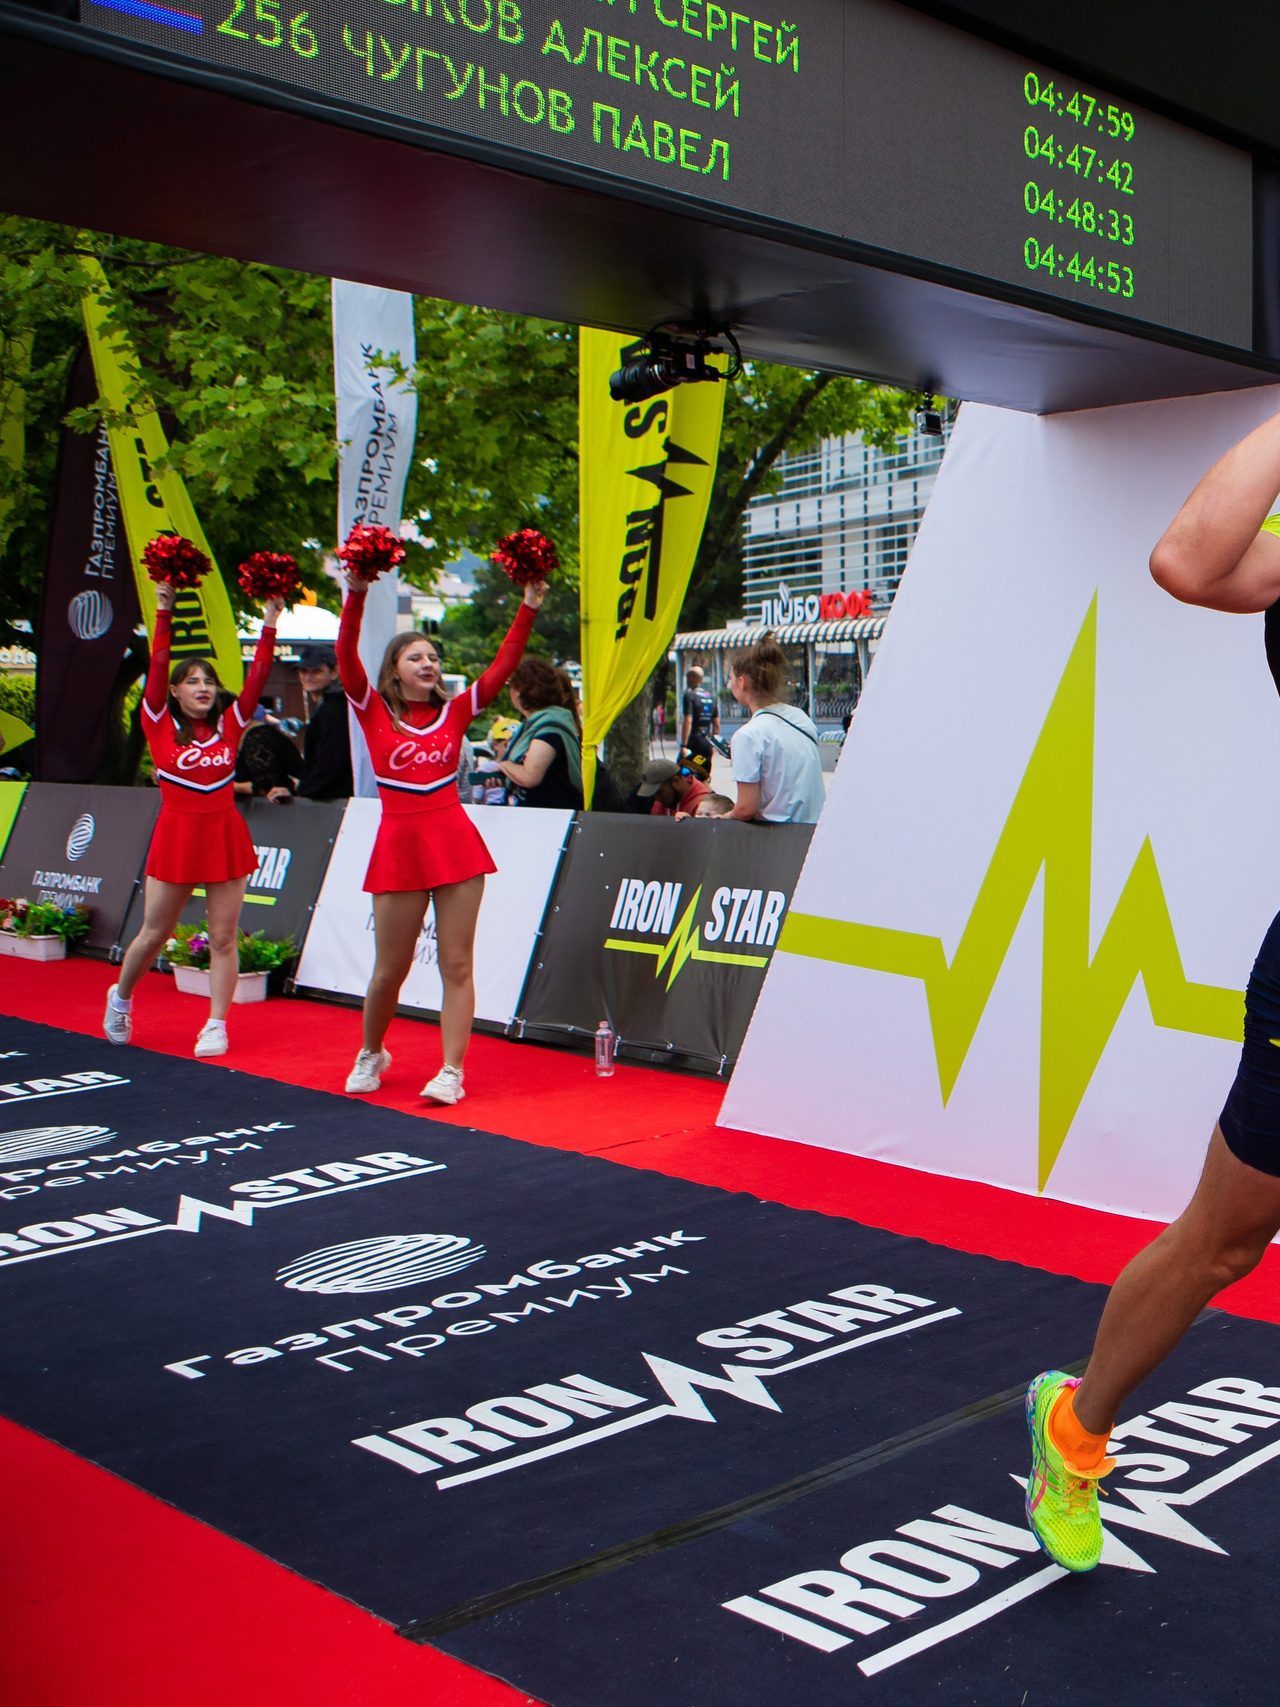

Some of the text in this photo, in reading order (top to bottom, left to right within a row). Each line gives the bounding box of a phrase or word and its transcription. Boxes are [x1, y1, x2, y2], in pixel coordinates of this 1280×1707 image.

[541, 20, 740, 118] АЛЕКСЕЙ
[655, 0, 799, 73] СЕРГЕЙ
[217, 0, 730, 181] 256 ЧУГУНОВ ПАВЕЛ
[1024, 72, 1135, 142] 04:47:59
[1024, 126, 1135, 196] 04:47:42
[1024, 181, 1135, 246] 04:48:33
[1024, 237, 1135, 298] 04:44:53
[84, 416, 113, 577] ГАЗПРОМБАН
[369, 413, 398, 526] РЕМИУМ
[169, 590, 212, 661] IRO
[177, 747, 232, 771] Cool
[389, 741, 453, 771] Cool
[247, 845, 292, 890] TAR
[610, 878, 786, 946] IRON STAR
[0, 1151, 435, 1257] RON STAR
[163, 1230, 706, 1379] Газпромбанк
[314, 1261, 690, 1373] Премиум
[350, 1283, 937, 1474] IRON STAR
[720, 1503, 1040, 1652] IRON
